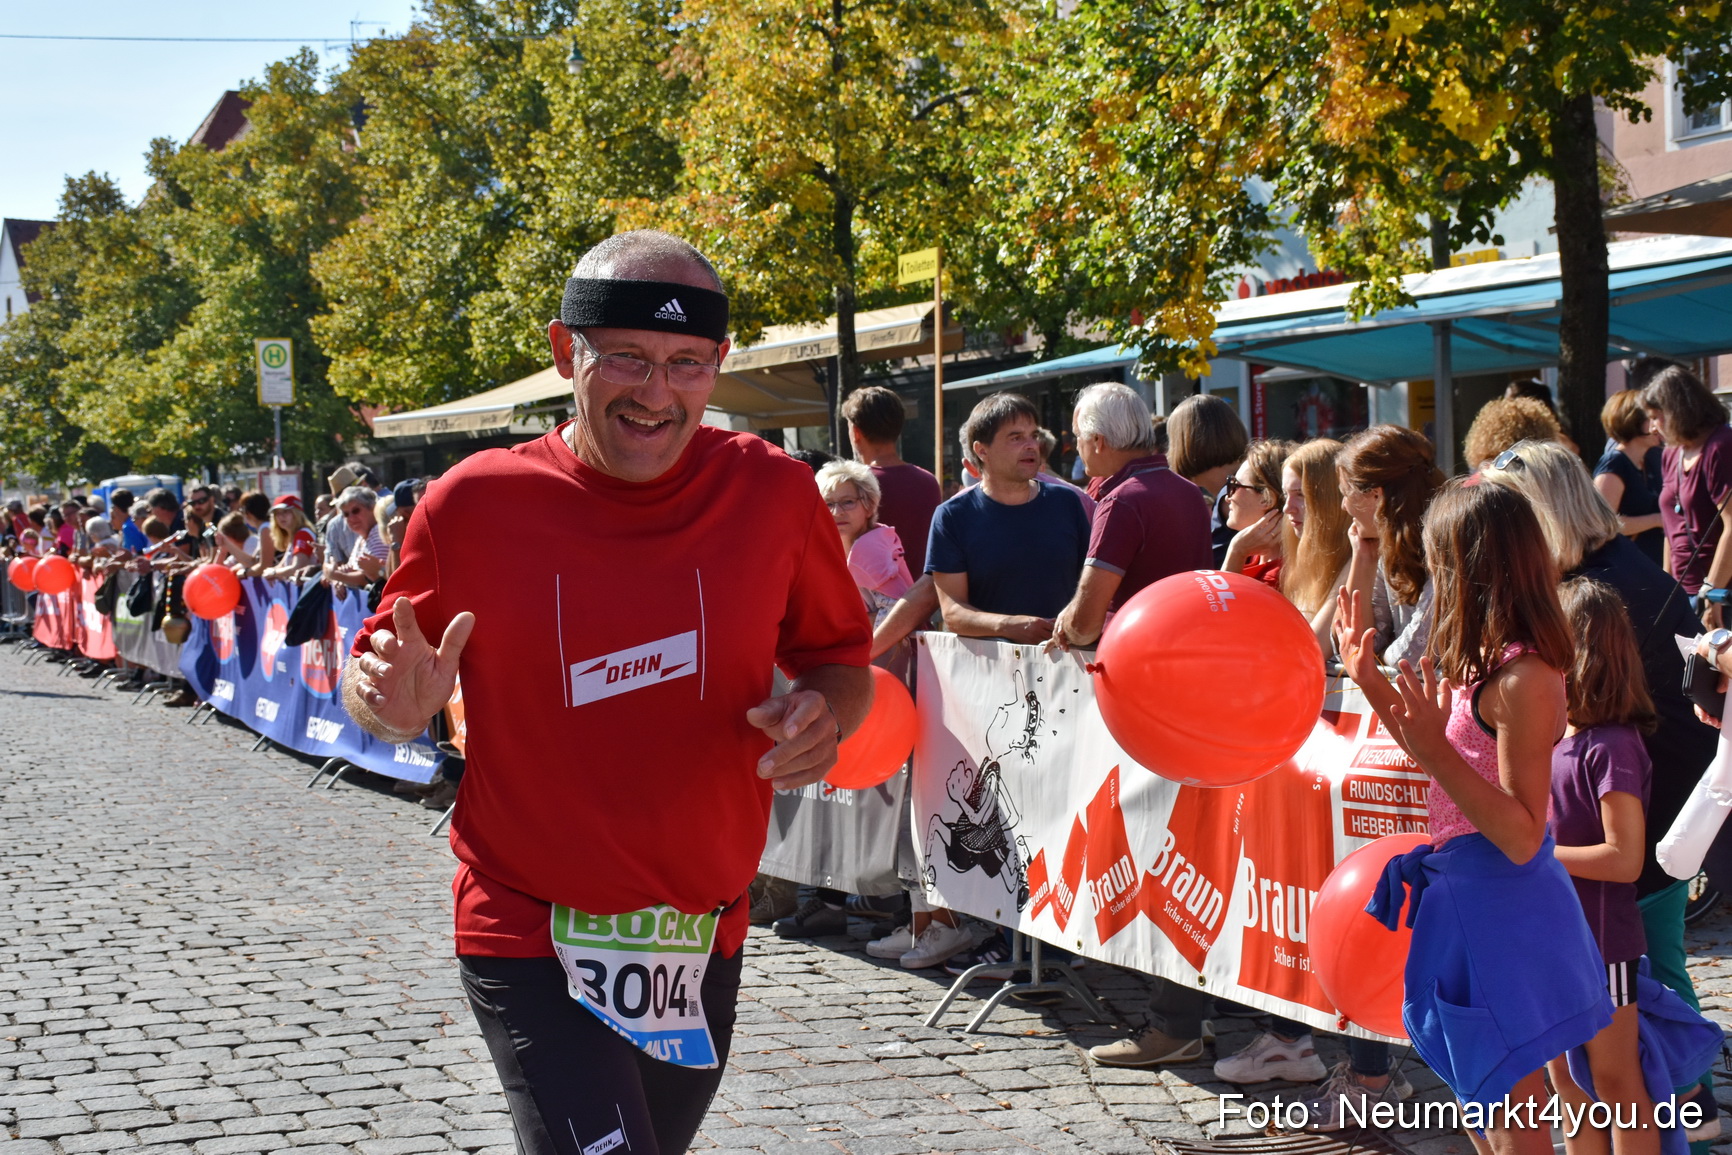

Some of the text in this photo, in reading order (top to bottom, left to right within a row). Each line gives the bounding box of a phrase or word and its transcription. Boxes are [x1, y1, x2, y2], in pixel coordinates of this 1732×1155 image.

[906, 260, 935, 275] Toiletten
[655, 310, 687, 322] adidas
[269, 349, 280, 362] H
[606, 653, 662, 684] DEHN
[1235, 793, 1244, 816] 1929
[1087, 855, 1135, 915] Braun
[1146, 827, 1223, 931] Braun
[1110, 900, 1126, 915] Sicher
[1163, 900, 1184, 925] Sicher
[1182, 919, 1193, 935] ist
[571, 909, 702, 944] BOCK
[1274, 945, 1310, 972] Sicher ist
[575, 959, 687, 1019] 3004
[595, 1138, 613, 1153] DEHN
